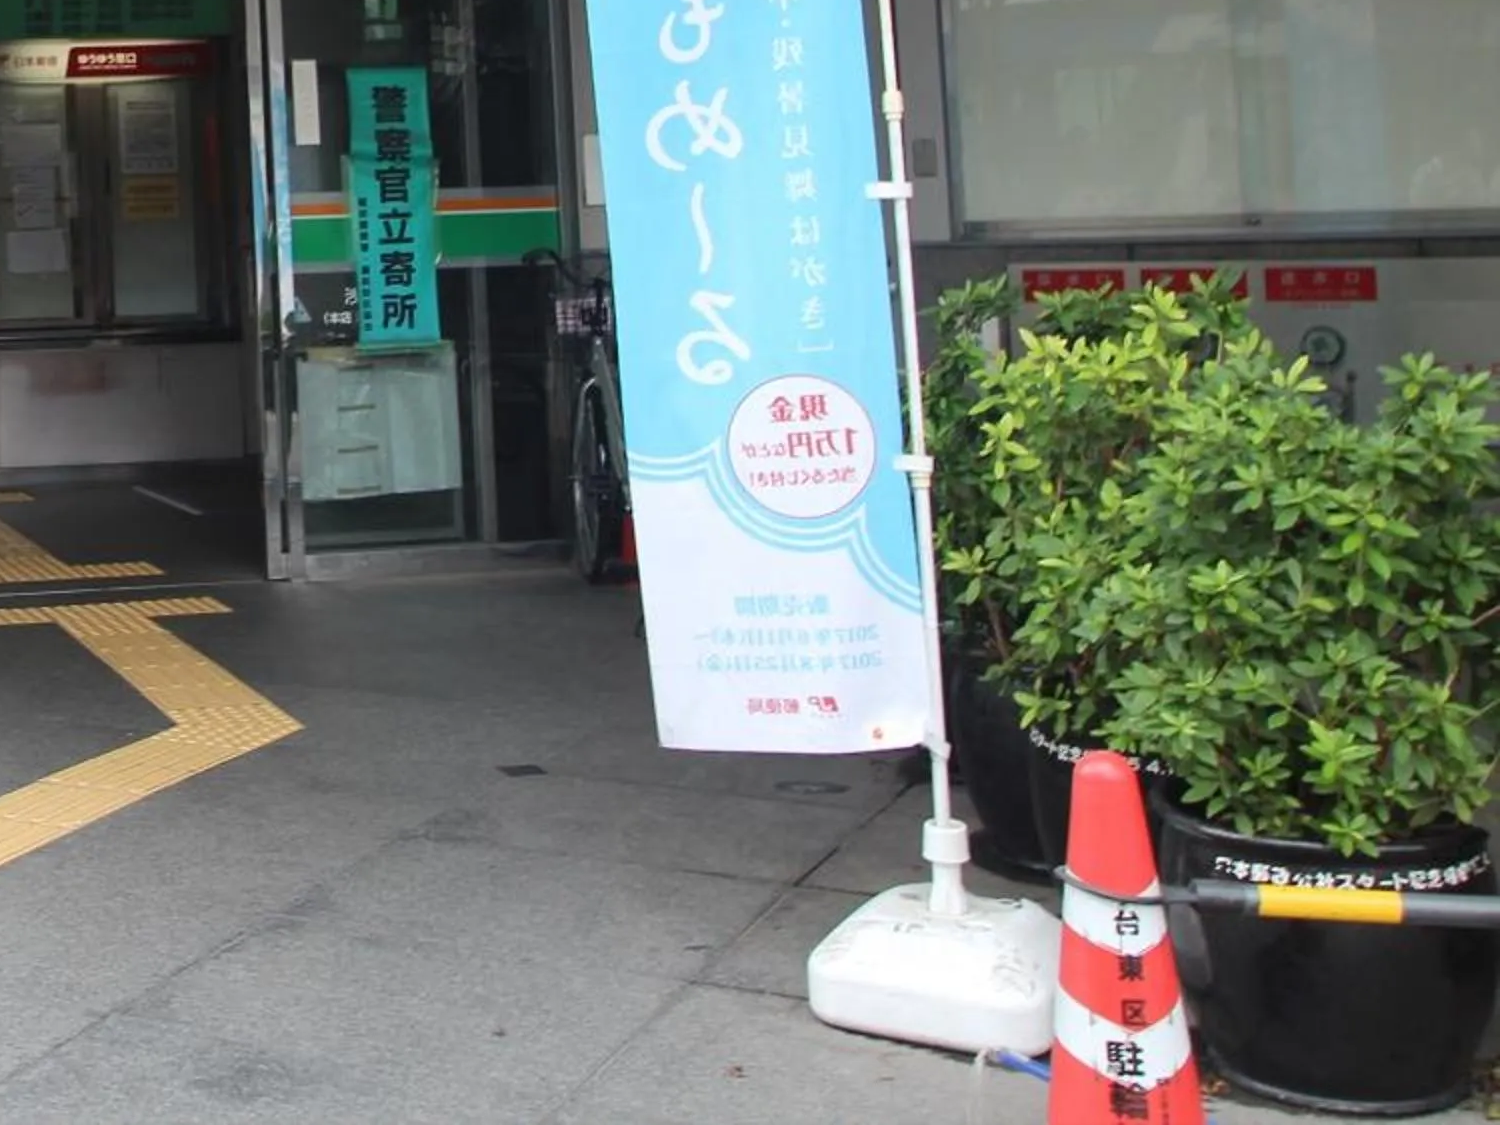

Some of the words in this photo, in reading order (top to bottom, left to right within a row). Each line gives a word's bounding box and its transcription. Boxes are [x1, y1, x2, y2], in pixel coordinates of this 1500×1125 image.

[371, 84, 418, 331] 警察官立寄所
[1113, 907, 1146, 1028] 台東区
[1105, 1040, 1149, 1125] 駐輪
